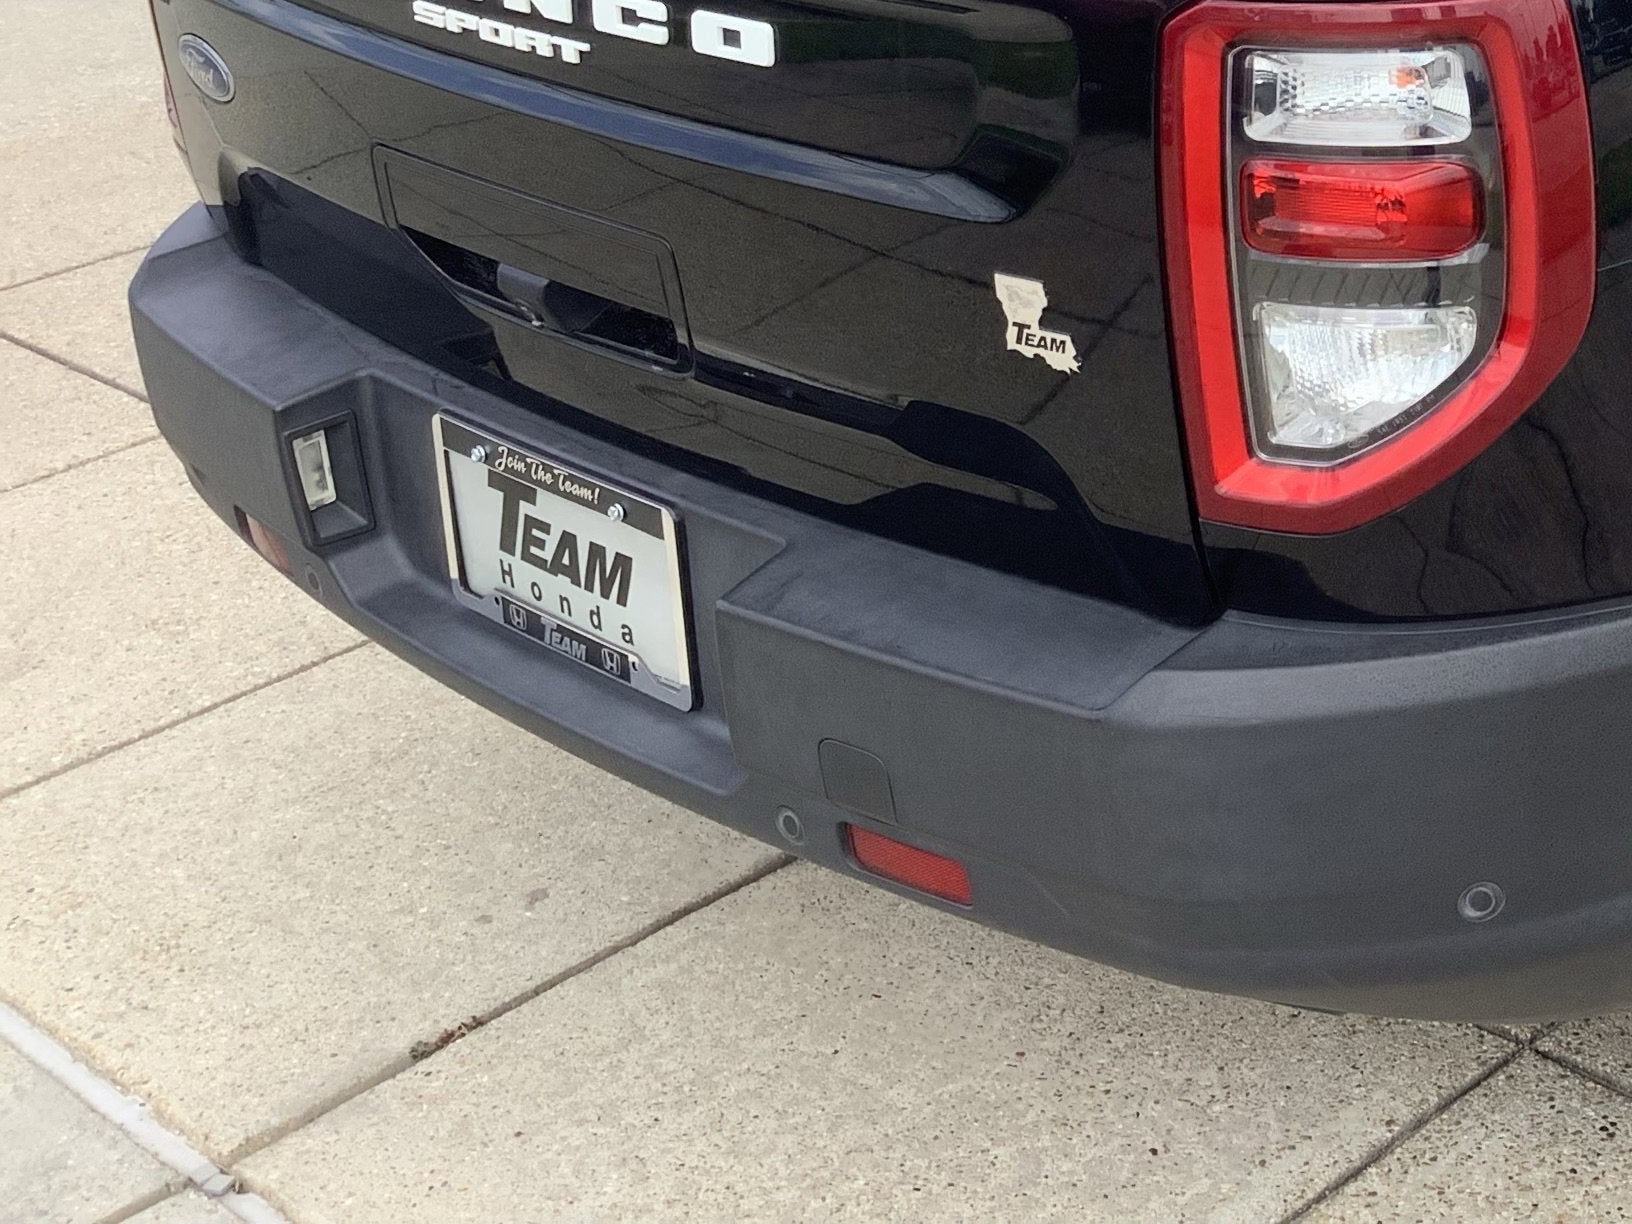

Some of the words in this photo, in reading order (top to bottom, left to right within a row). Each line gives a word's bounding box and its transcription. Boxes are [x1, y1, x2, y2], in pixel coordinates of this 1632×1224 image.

[412, 0, 592, 65] SPORT
[1012, 321, 1067, 354] TEAM
[494, 446, 527, 474] Join
[525, 457, 555, 485] The
[553, 468, 600, 505] Team!
[487, 467, 633, 608] TEAM
[498, 558, 635, 646] Honda
[540, 616, 587, 662] TEAM
